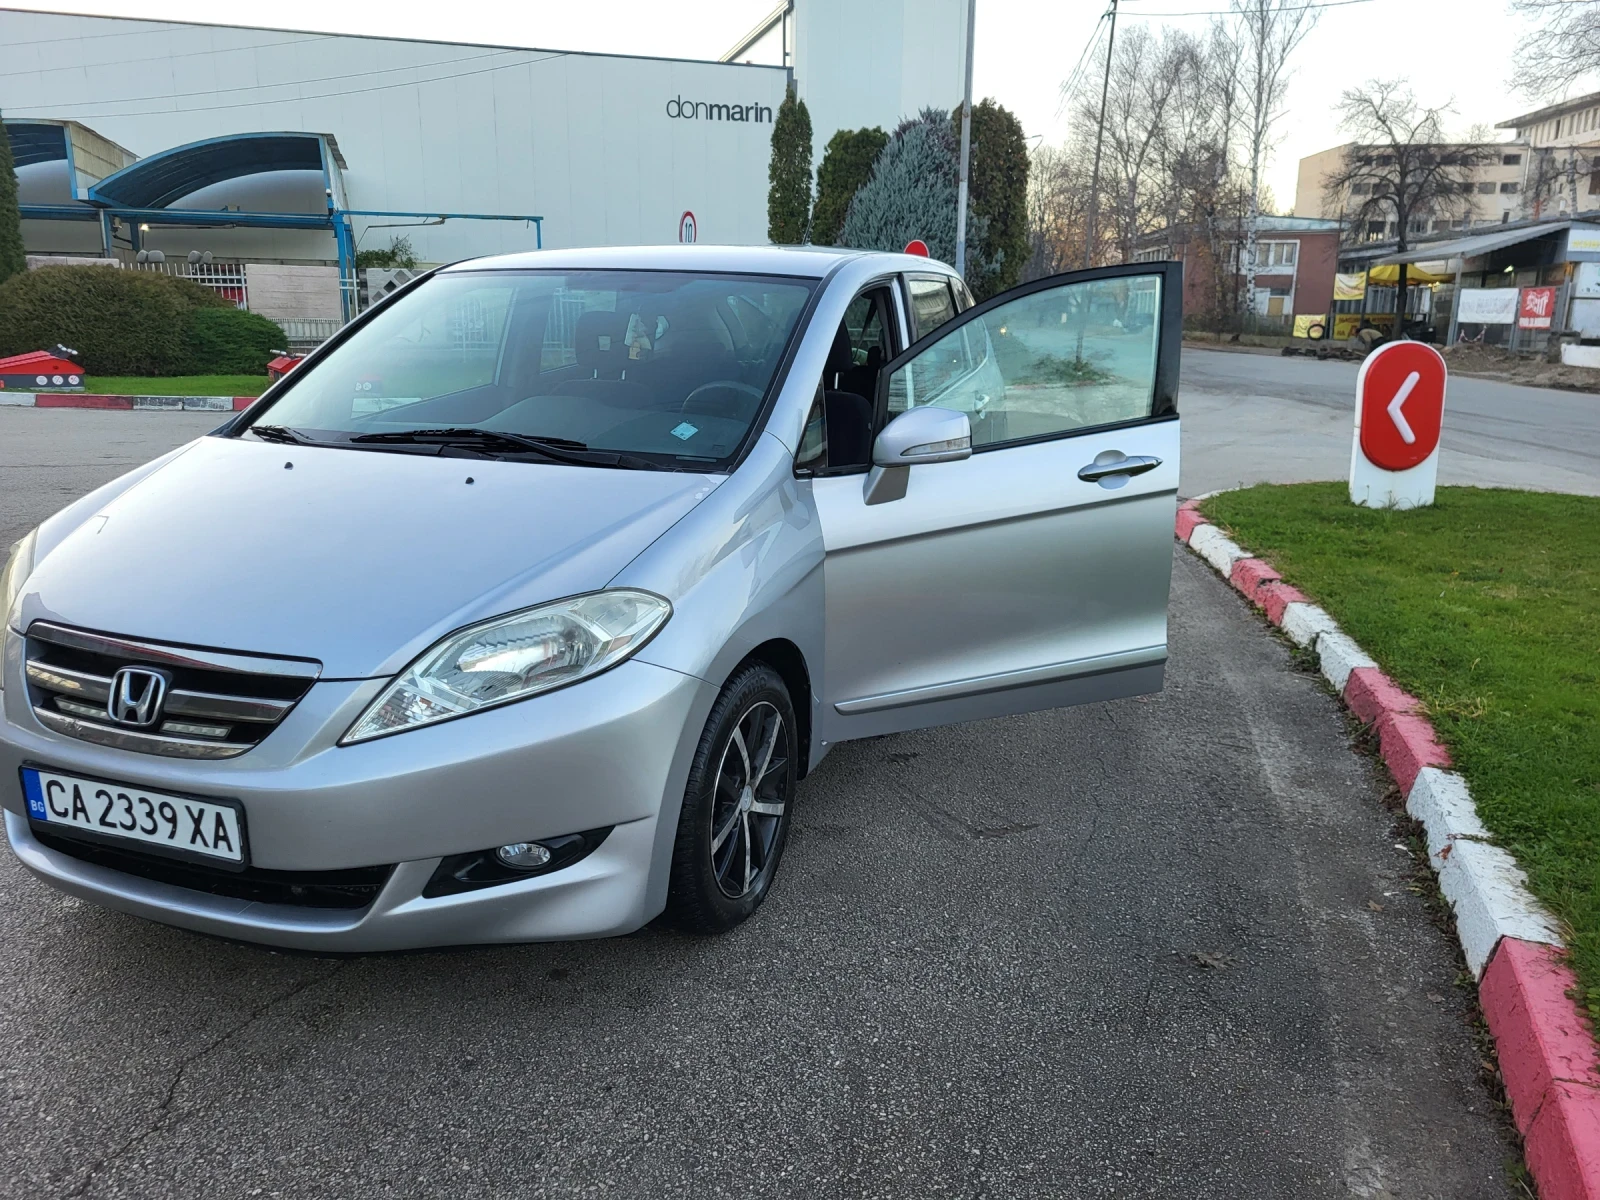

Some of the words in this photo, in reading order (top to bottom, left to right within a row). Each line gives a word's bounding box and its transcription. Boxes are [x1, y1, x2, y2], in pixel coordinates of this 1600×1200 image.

[666, 94, 772, 123] donmarin
[685, 222, 693, 243] 10
[31, 800, 45, 813] BG
[95, 789, 178, 840] 2339
